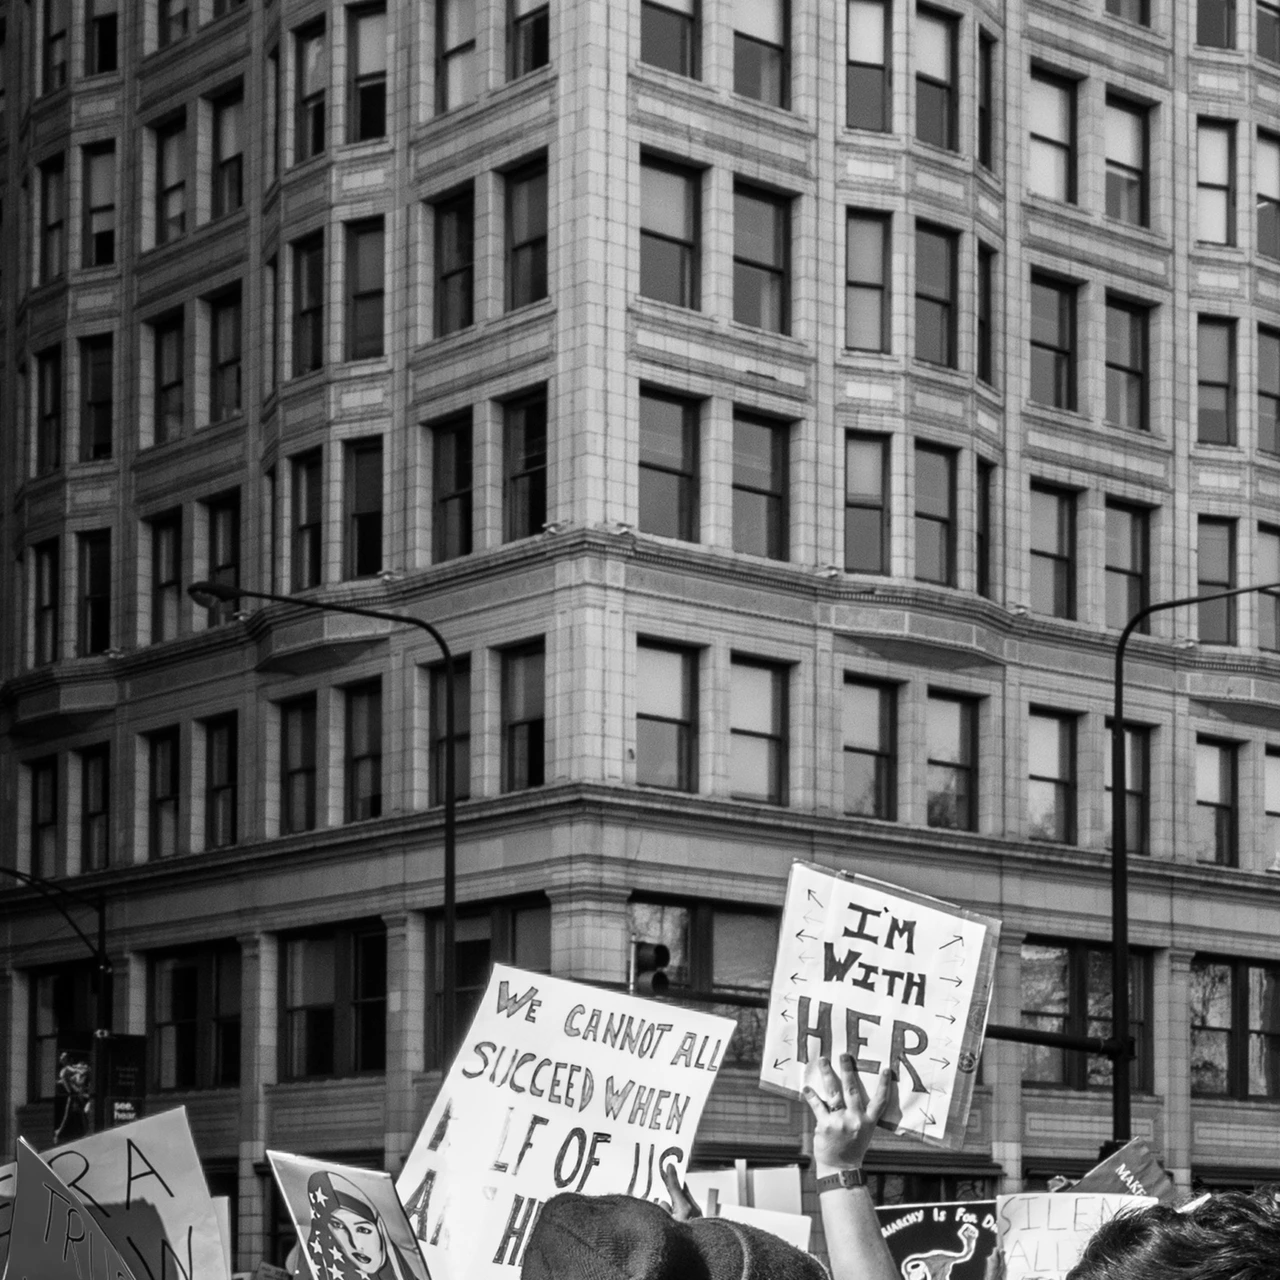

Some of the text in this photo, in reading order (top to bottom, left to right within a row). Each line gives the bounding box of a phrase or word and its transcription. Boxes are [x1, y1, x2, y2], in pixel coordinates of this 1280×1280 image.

[823, 940, 927, 1008] WITH
[563, 1003, 674, 1060] CANNOT
[670, 1031, 722, 1073] ALL
[796, 995, 931, 1095] HER
[461, 1041, 691, 1135] SUCCEED WHEN
[553, 1126, 613, 1195] OF
